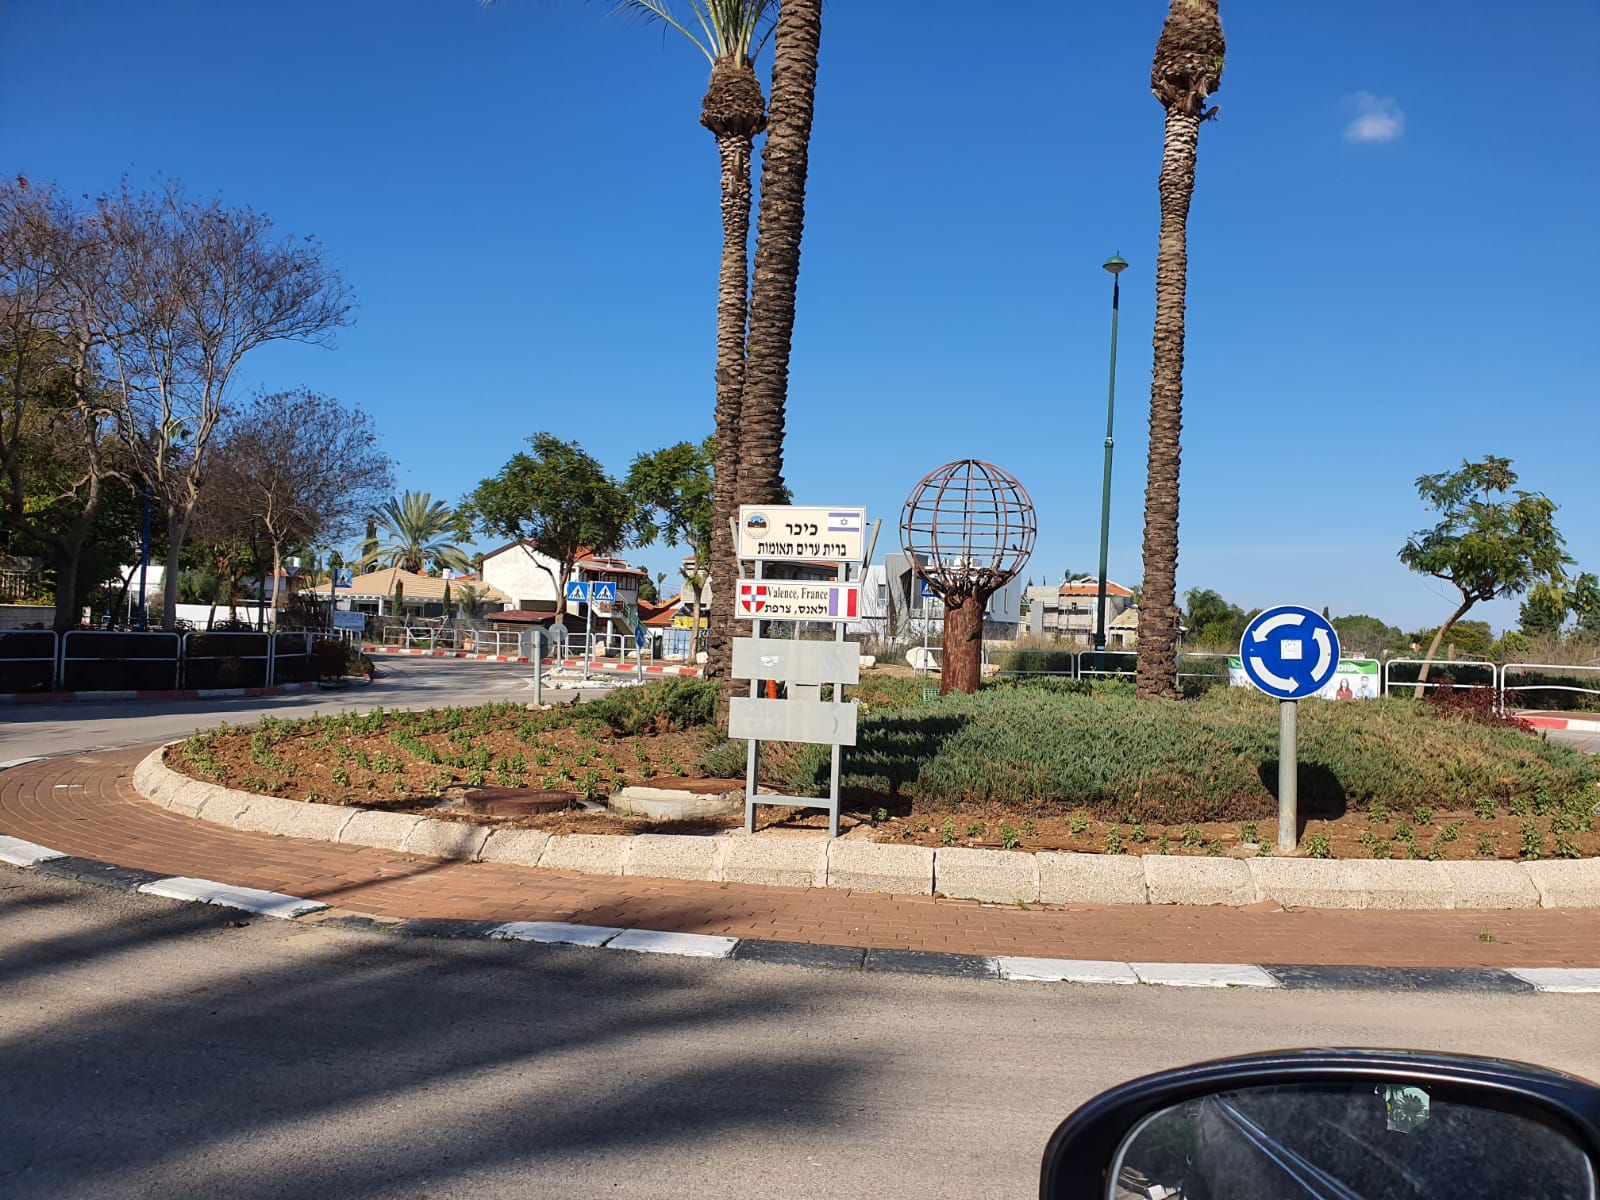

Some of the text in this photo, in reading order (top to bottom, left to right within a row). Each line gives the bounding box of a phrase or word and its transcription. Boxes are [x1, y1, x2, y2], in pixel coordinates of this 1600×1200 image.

[785, 522, 818, 536] כיכר
[757, 542, 847, 556] ברית ערים תאומות
[767, 586, 828, 600] Valence, France
[764, 604, 827, 615] ולאנס, צרפת
